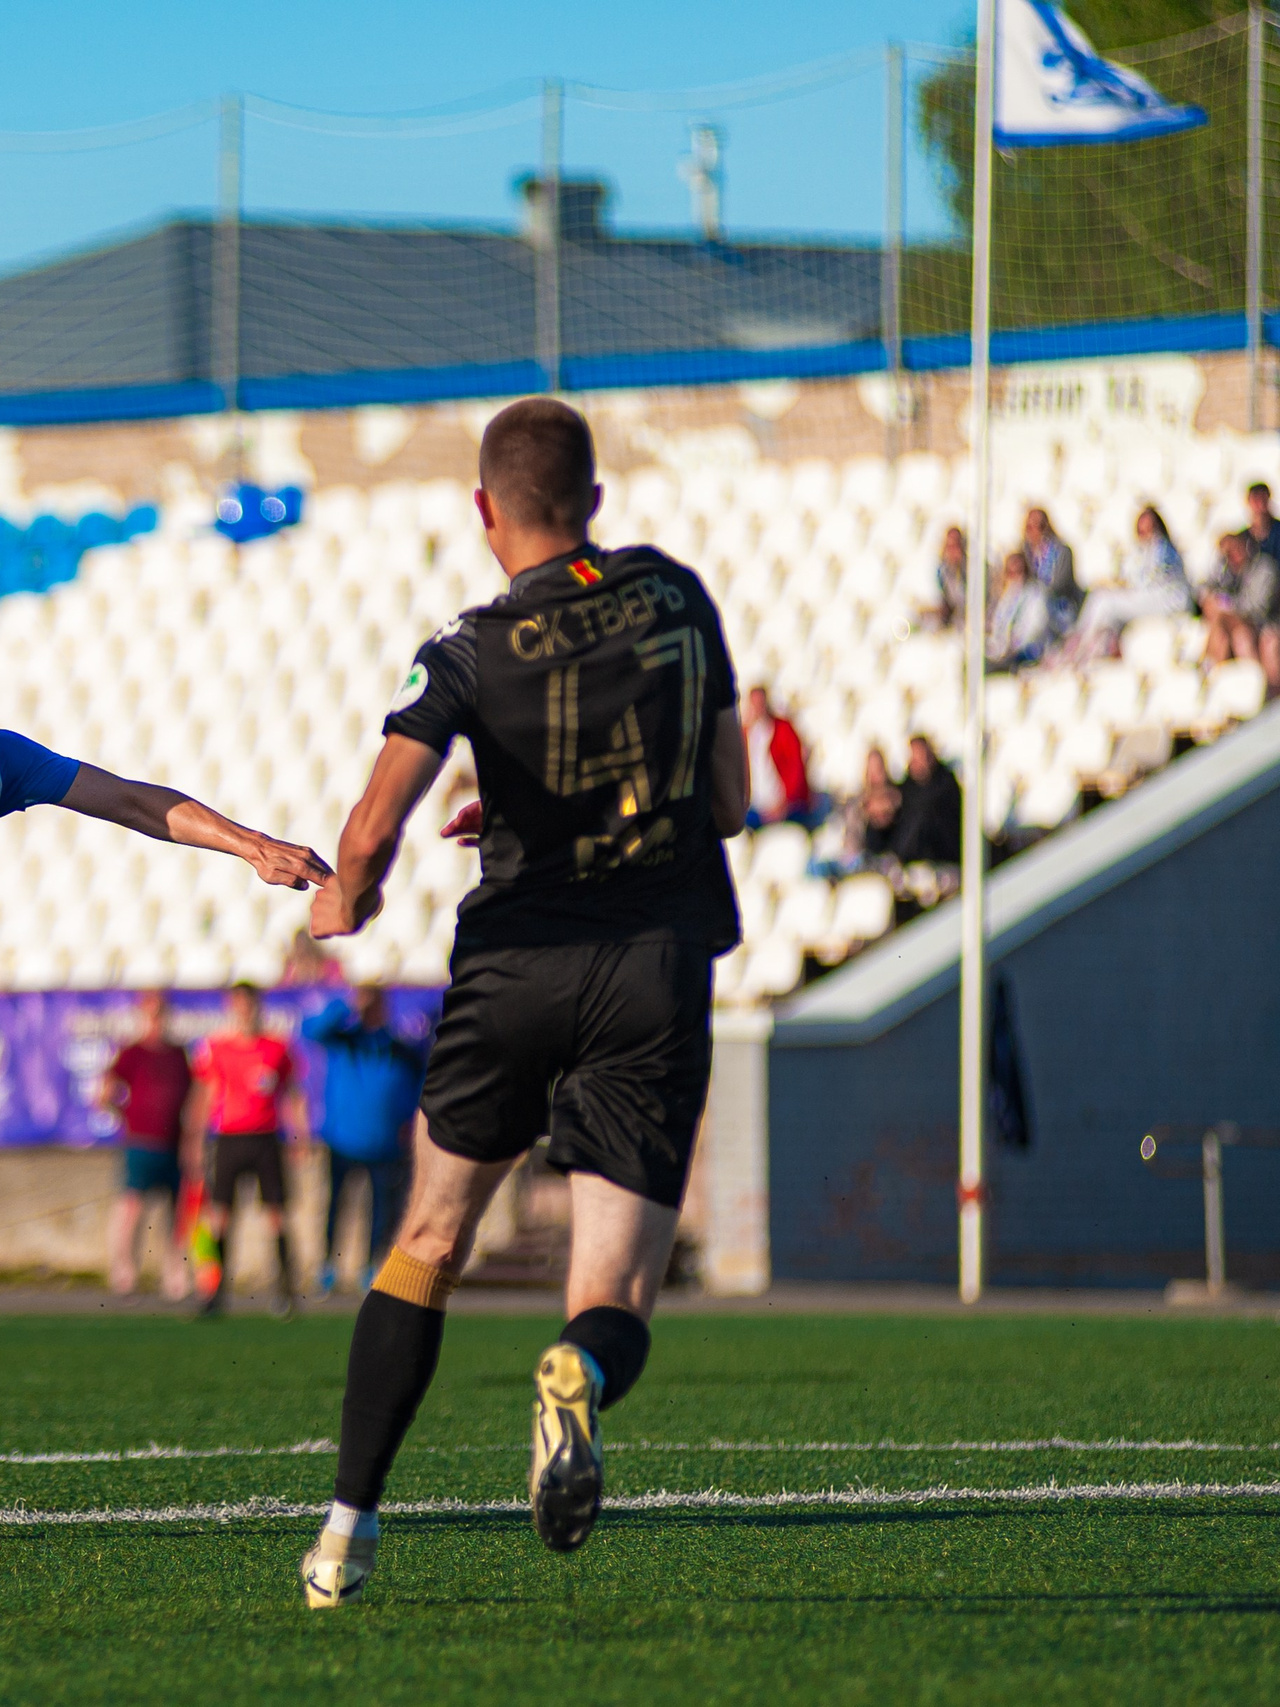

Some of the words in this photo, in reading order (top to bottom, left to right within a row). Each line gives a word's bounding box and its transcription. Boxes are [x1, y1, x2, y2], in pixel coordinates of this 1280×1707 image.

[511, 608, 574, 661] СК
[571, 574, 686, 642] ТВЕРЬ
[545, 626, 706, 817] 47
